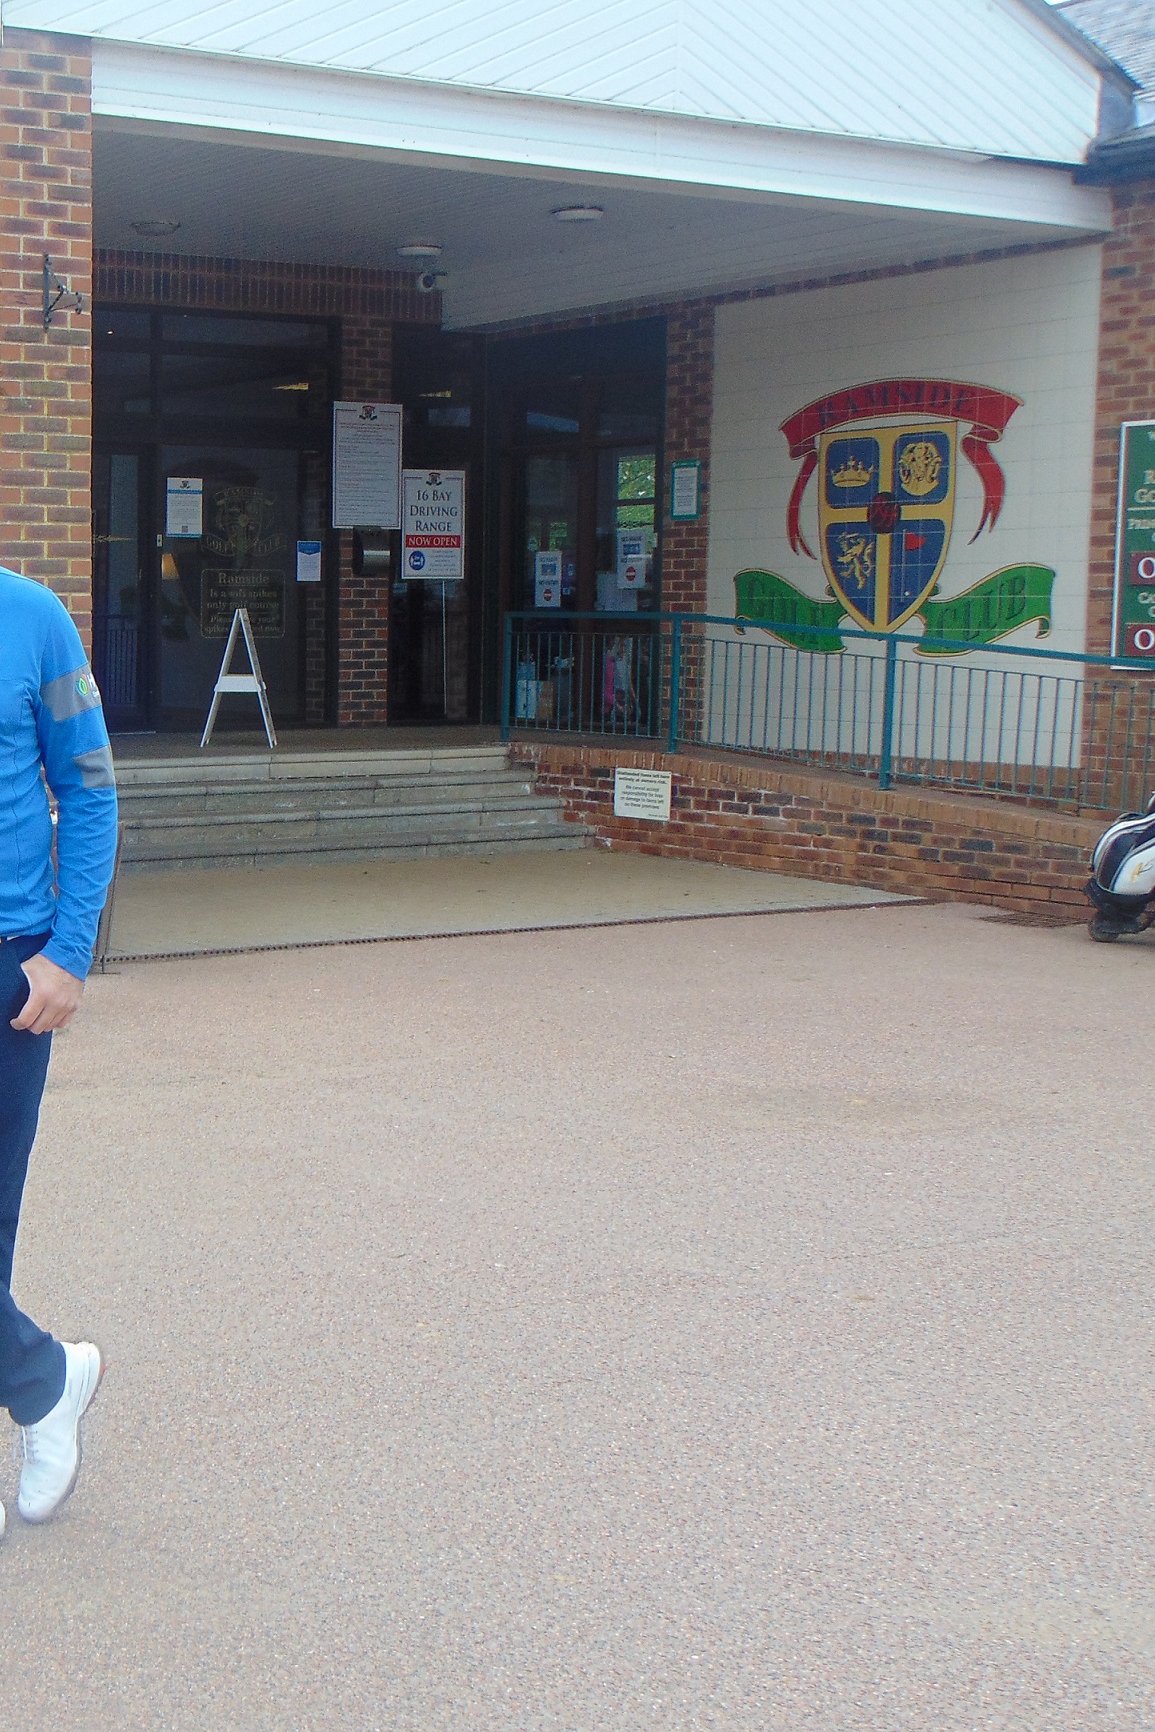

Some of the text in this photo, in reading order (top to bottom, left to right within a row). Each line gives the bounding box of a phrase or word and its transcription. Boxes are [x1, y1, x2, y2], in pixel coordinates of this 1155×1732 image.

[416, 489, 453, 502] 16 BAY
[409, 504, 458, 517] DRIVING
[415, 520, 453, 532] RANGE
[408, 536, 458, 546] NOW OPEN
